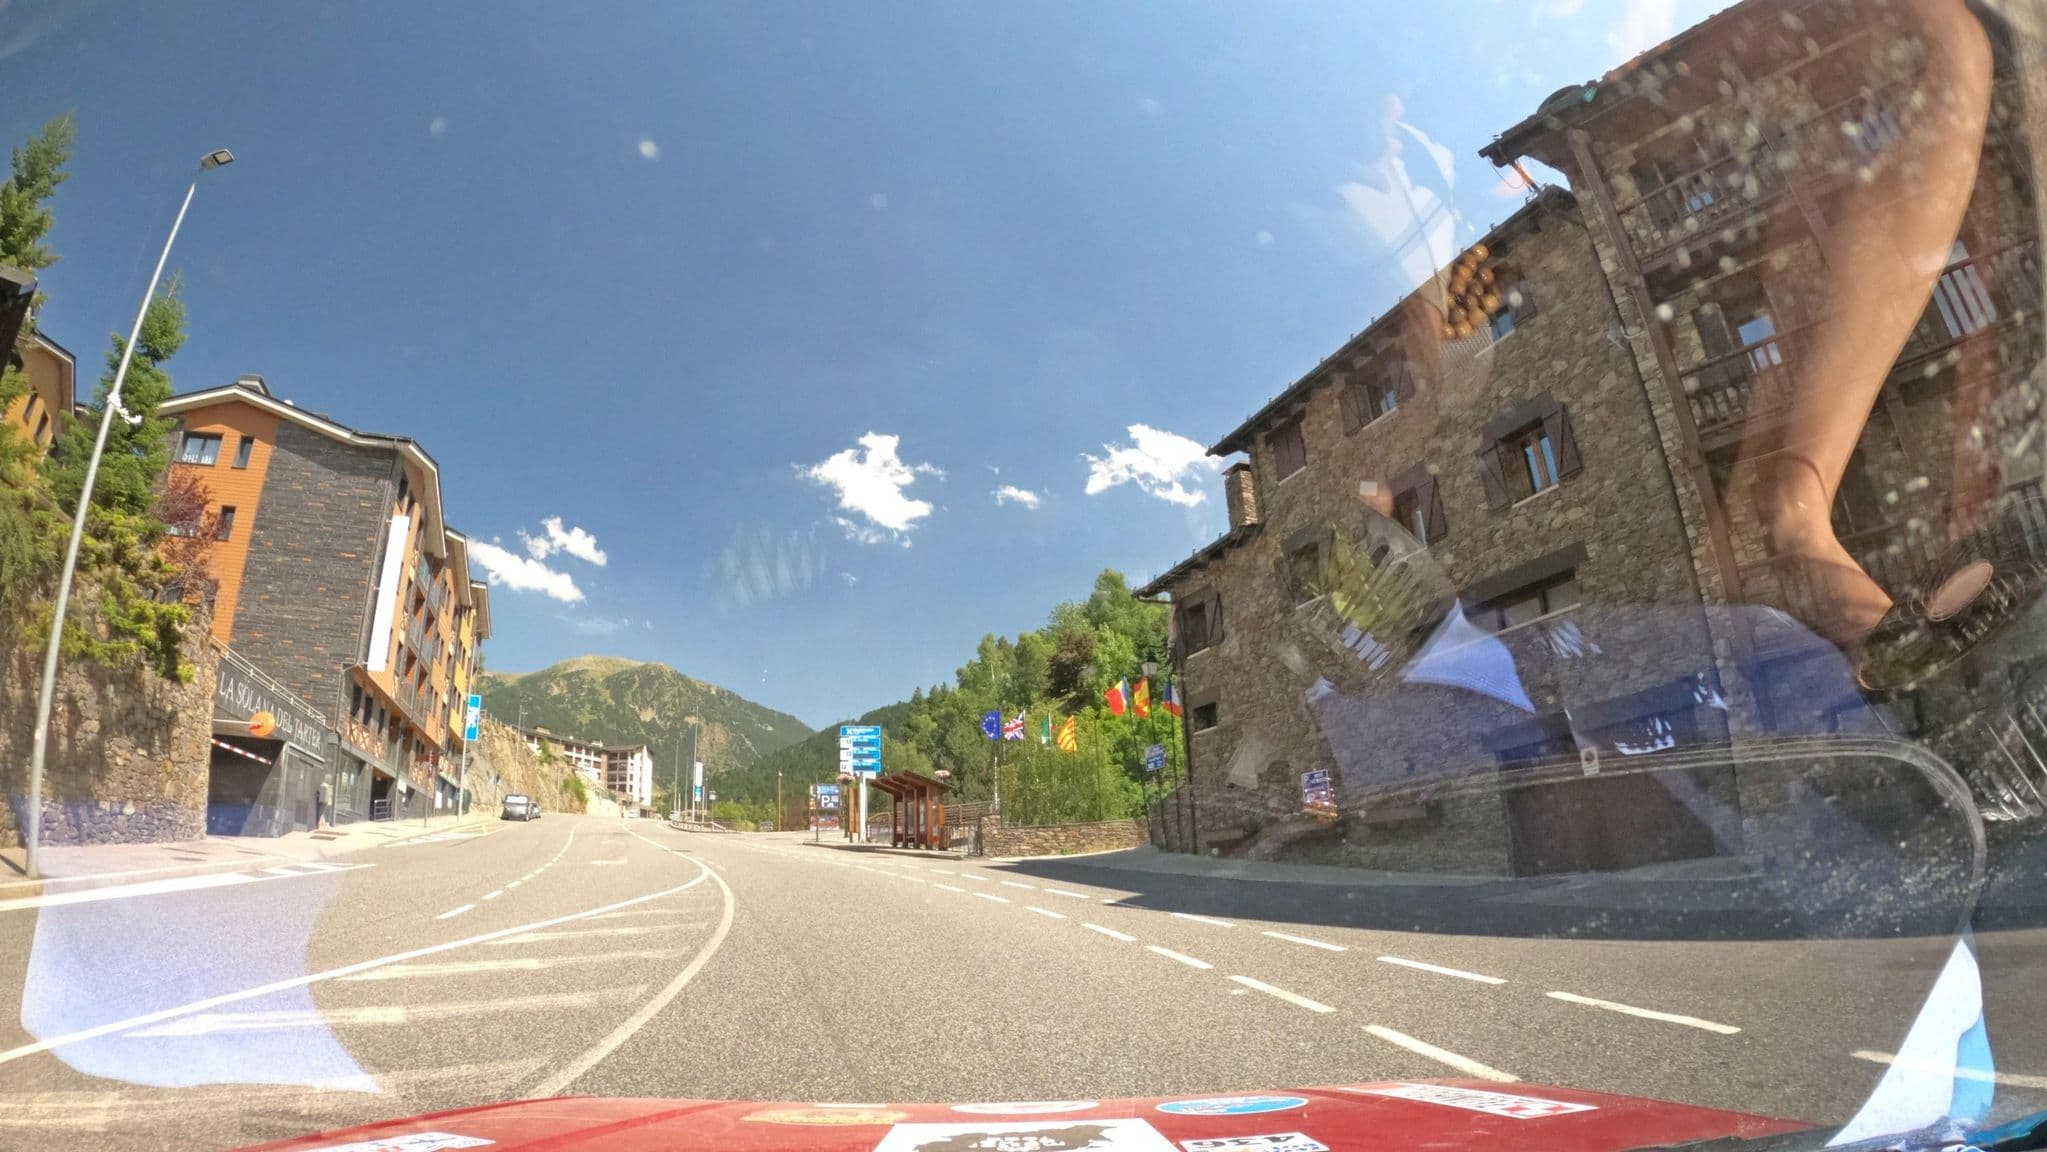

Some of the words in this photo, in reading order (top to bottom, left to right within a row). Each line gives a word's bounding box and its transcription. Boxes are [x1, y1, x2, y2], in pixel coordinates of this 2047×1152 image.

[219, 671, 234, 701] LA
[236, 681, 275, 716] SOLANA
[276, 707, 292, 733] DEL
[294, 718, 321, 751] TARTER
[1191, 1137, 1294, 1148] 436
